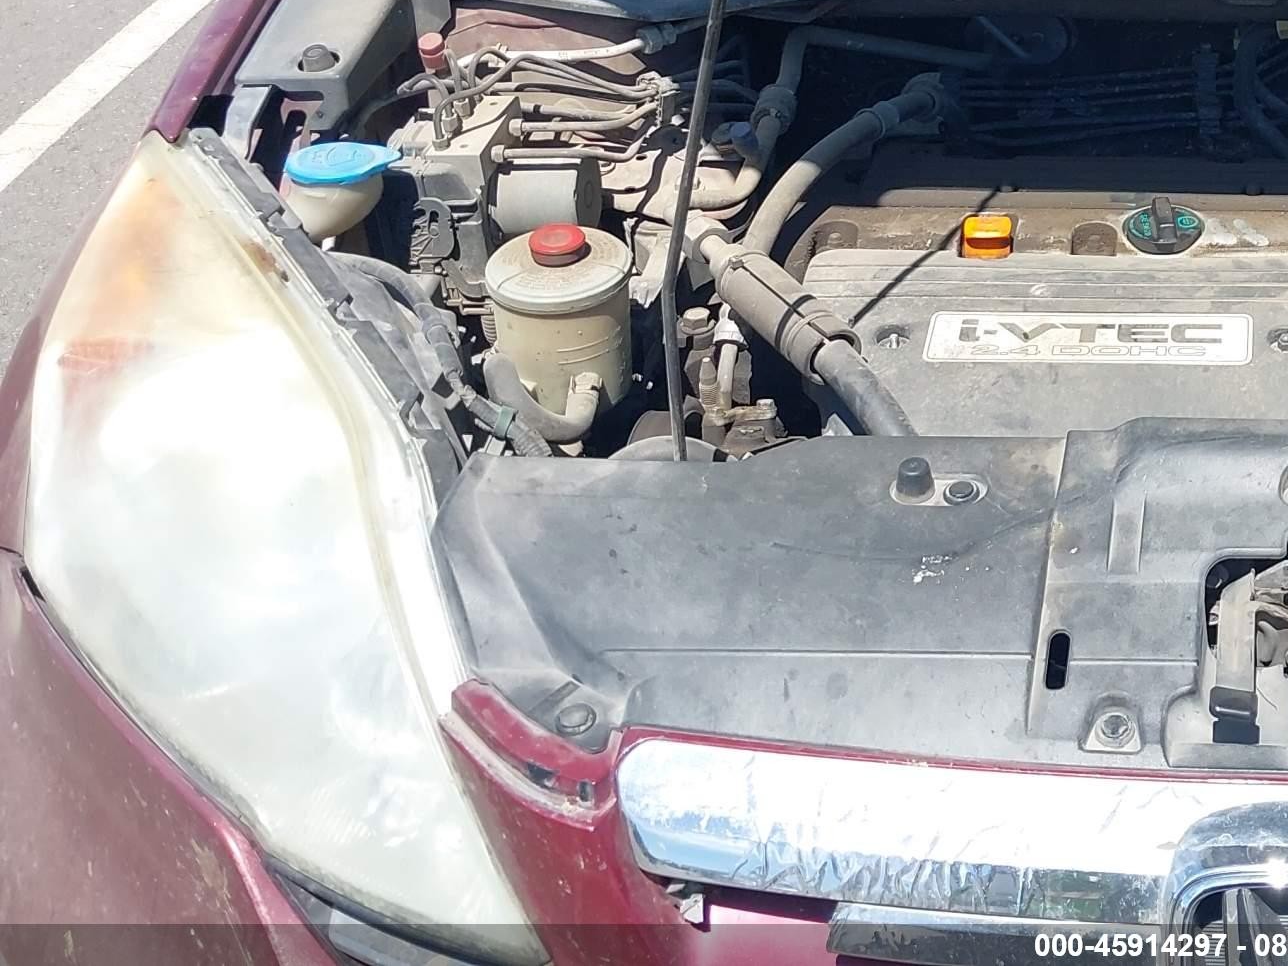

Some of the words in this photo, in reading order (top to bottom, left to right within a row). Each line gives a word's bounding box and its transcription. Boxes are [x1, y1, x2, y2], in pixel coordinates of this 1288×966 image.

[959, 319, 1223, 343] i-VTEC
[970, 345, 1041, 356] 2.4
[1052, 345, 1206, 356] DOHC
